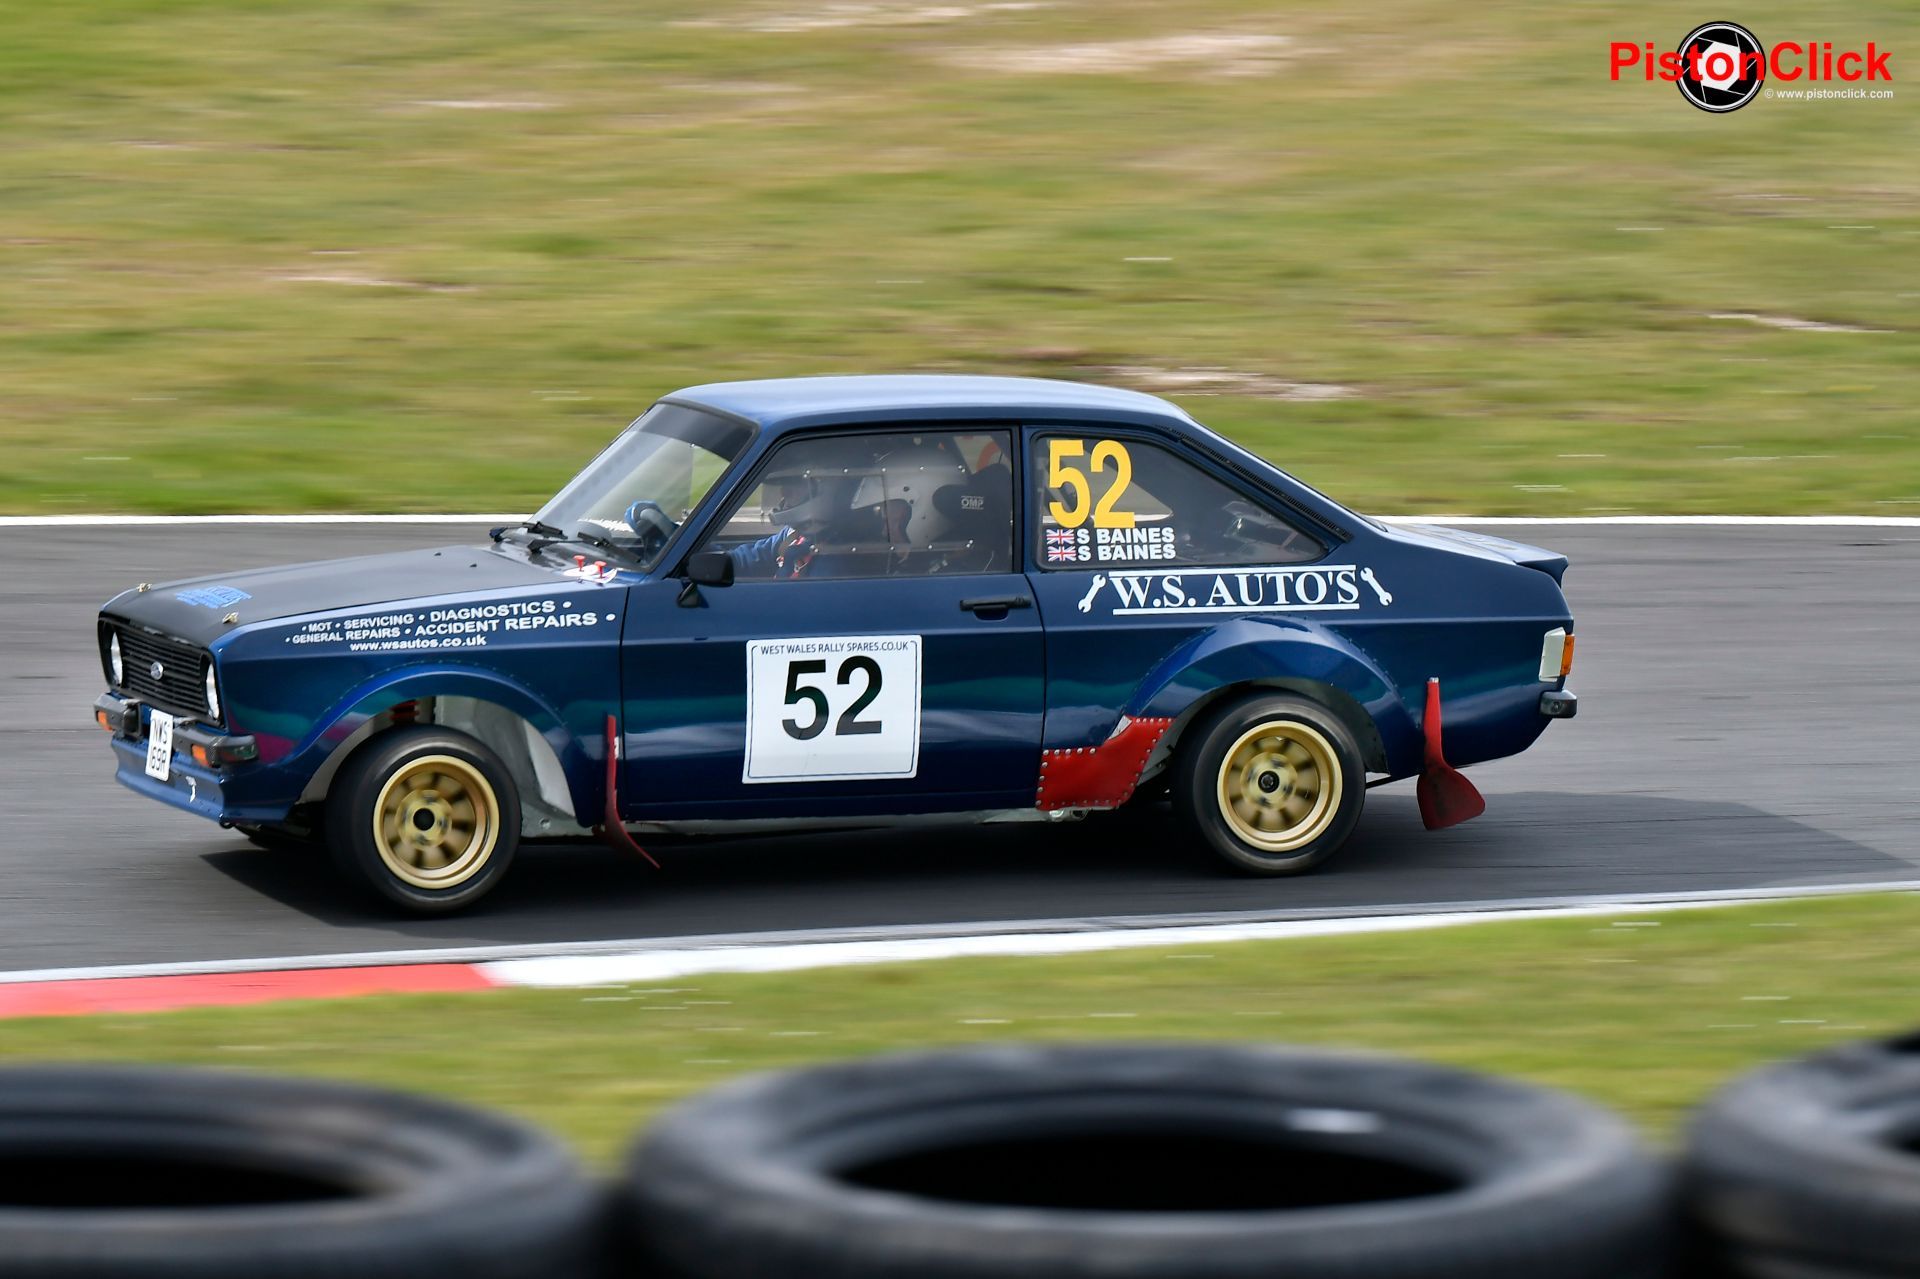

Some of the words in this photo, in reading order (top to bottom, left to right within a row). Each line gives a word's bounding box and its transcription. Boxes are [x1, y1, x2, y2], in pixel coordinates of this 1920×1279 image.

[1048, 439, 1136, 529] 52
[961, 498, 984, 508] OMP
[1076, 528, 1090, 544] S
[1096, 527, 1175, 544] BAINES
[1077, 545, 1091, 562] S
[1098, 544, 1177, 561] BAINES
[1109, 575, 1197, 608] W.S.
[1205, 570, 1359, 606] AUTO'S
[292, 632, 343, 644] GENERAL
[345, 627, 401, 641] REPAIRS
[415, 619, 500, 636] ACCIDENT
[505, 612, 598, 631] REPAIRS
[308, 621, 333, 633] MOT
[343, 614, 415, 630] SERVICING
[430, 600, 556, 622] DIAGNOSTICS
[350, 634, 487, 651] www.wsautos.co.uk
[761, 645, 785, 655] WEST
[786, 644, 816, 654] WALES
[818, 643, 844, 653] RALLY
[846, 641, 908, 652] SPARES.CO.UK
[781, 655, 883, 741] 52
